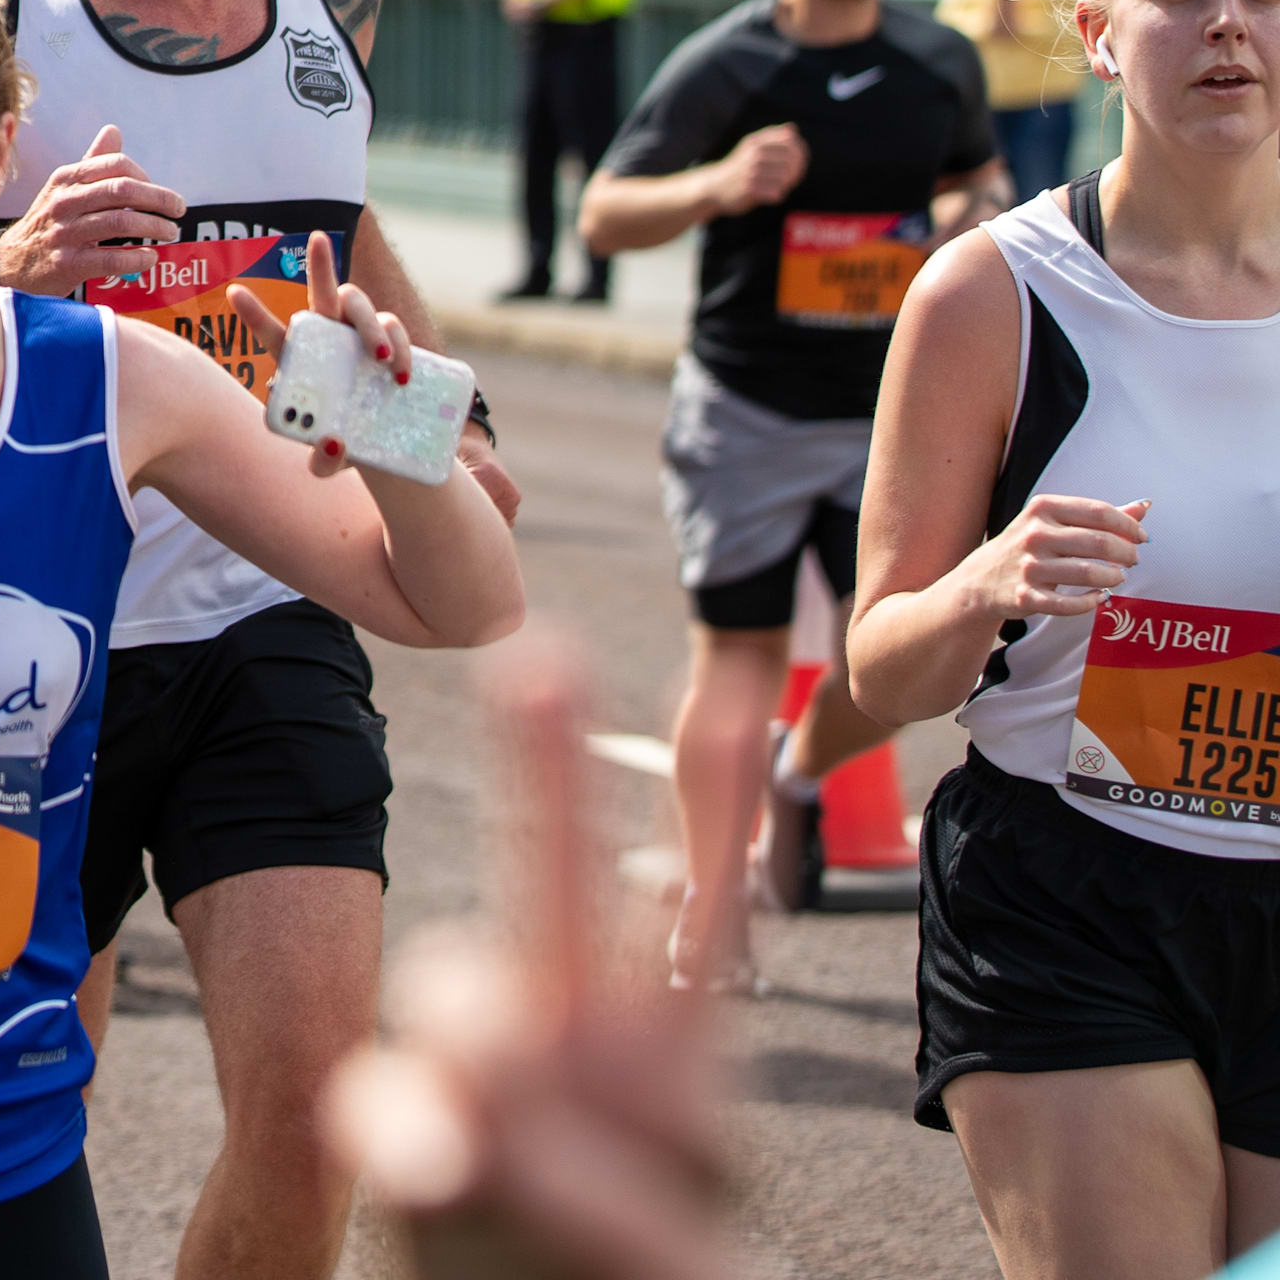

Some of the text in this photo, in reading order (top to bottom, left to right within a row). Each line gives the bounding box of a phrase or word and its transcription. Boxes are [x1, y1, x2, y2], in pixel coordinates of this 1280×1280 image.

[1130, 618, 1231, 654] AJBell
[1181, 683, 1280, 744] ELLIE
[1173, 737, 1280, 799] 1225
[2, 790, 31, 803] north
[1108, 784, 1261, 821] GOODMOVE
